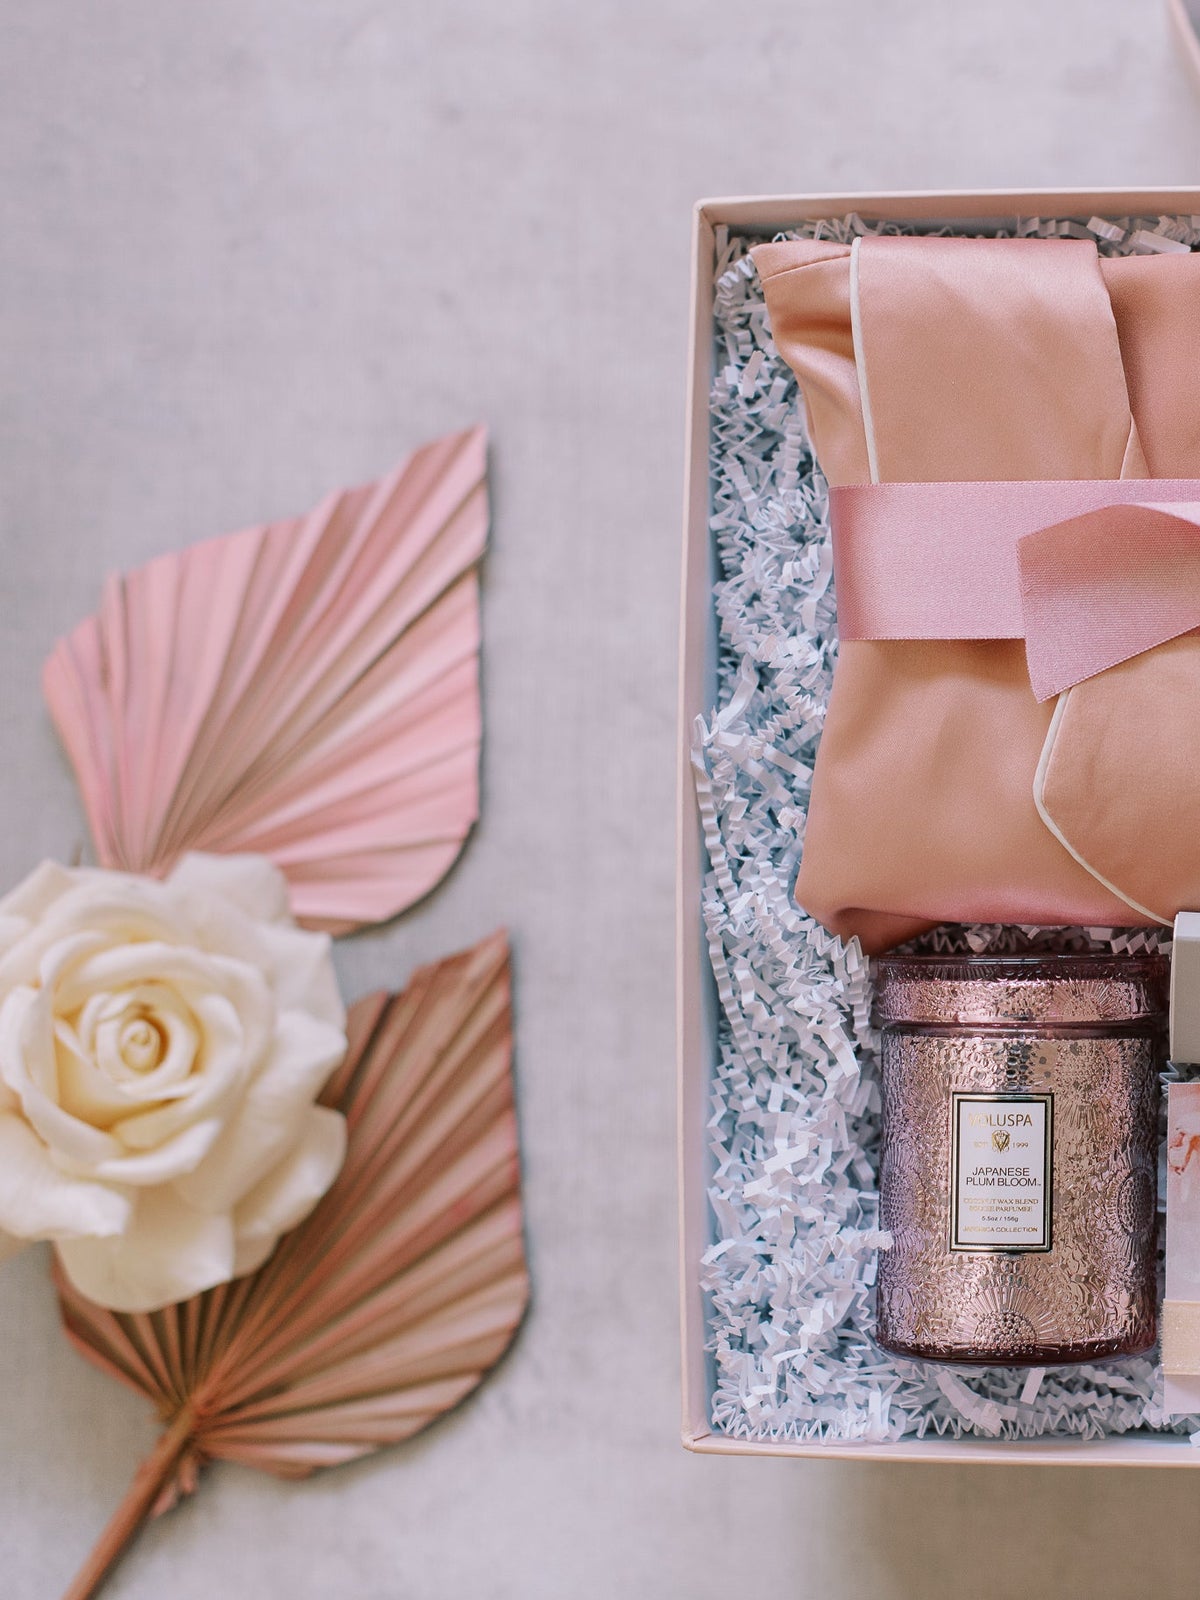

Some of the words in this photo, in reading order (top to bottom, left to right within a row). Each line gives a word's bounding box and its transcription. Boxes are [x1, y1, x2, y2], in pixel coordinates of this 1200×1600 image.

[967, 1113, 1033, 1127] VOLUSPA
[972, 1167, 1030, 1177] JAPANESE
[966, 1177, 995, 1187] PLUM
